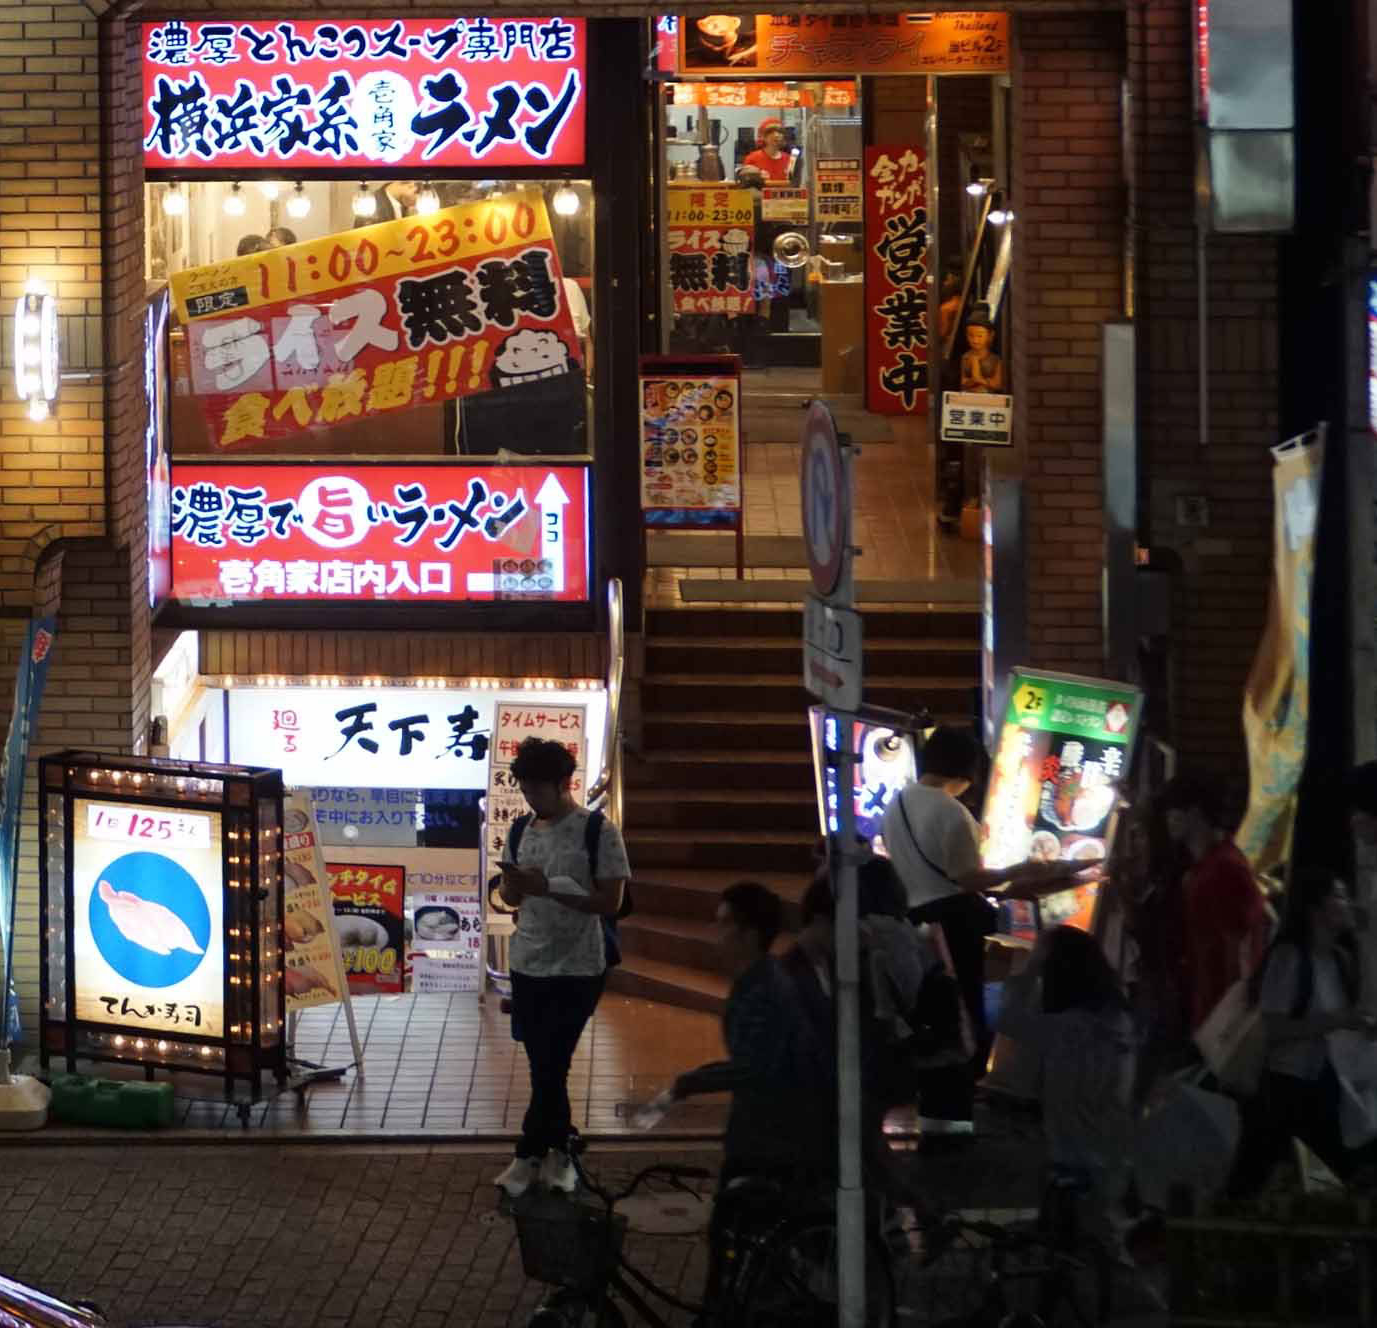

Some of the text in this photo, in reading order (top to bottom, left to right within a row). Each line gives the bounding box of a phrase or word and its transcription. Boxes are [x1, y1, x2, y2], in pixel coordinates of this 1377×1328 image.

[148, 18, 576, 64] 濃厚とんこつスープ専門店
[146, 71, 360, 158] 横浜家系
[410, 68, 578, 158] ラーメン
[397, 249, 559, 351] 無料
[203, 288, 400, 391] ライス
[219, 559, 451, 595] 壱角家店内入口
[323, 702, 490, 761] 天下寿
[500, 712, 582, 730] タイムサービス
[126, 810, 174, 841] 125
